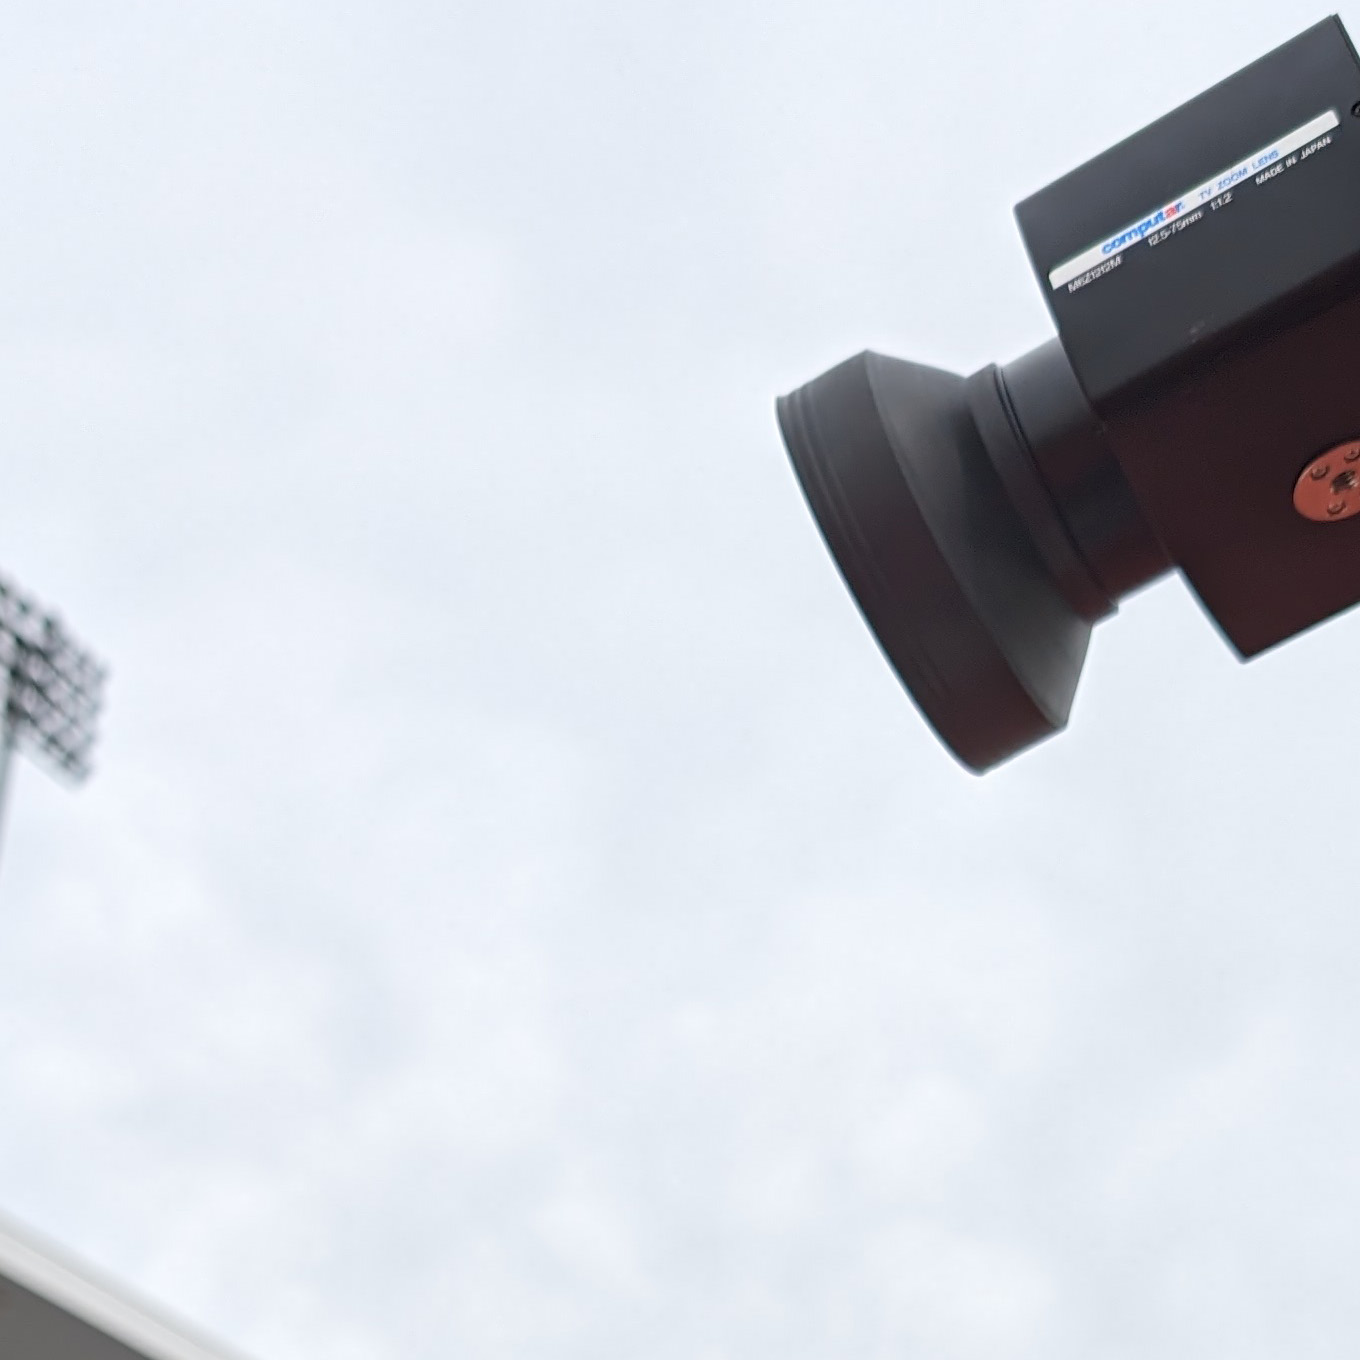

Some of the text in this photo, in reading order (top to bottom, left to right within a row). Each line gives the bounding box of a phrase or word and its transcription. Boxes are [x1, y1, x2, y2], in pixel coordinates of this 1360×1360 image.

[1255, 164, 1286, 187] MADE
[1286, 155, 1299, 169] IN
[1300, 135, 1333, 161] JAPAN
[1101, 149, 1280, 255] computar TV ZOOM LENS
